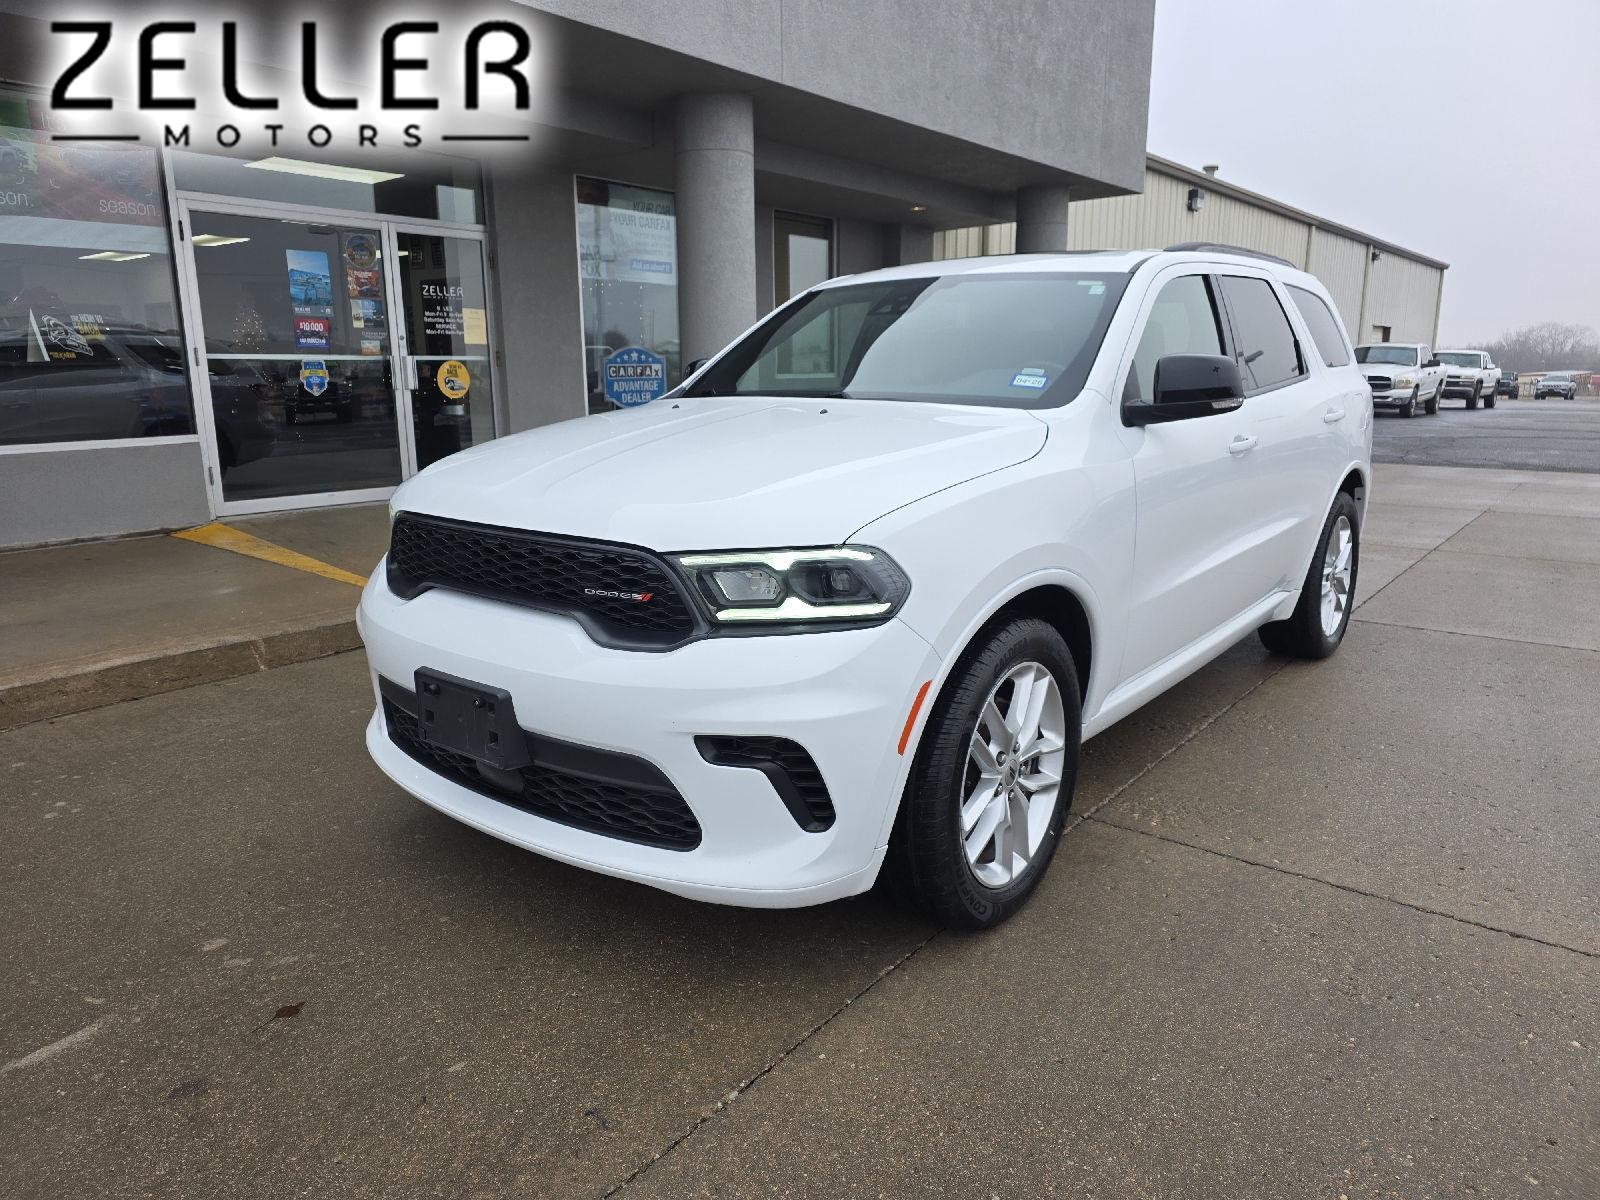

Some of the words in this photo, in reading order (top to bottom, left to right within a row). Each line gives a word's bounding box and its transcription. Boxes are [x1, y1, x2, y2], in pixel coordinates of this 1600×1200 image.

[99, 199, 161, 217] season.
[633, 201, 654, 214] YOUR
[655, 204, 672, 216] CAR
[614, 212, 637, 227] YOUR
[639, 215, 671, 232] CARFAX
[422, 284, 464, 297] ZELLER
[608, 365, 661, 378] CARFAX
[613, 380, 659, 392] ADVANTAGE
[621, 391, 653, 404] DEALER
[584, 588, 642, 600] DODGE
